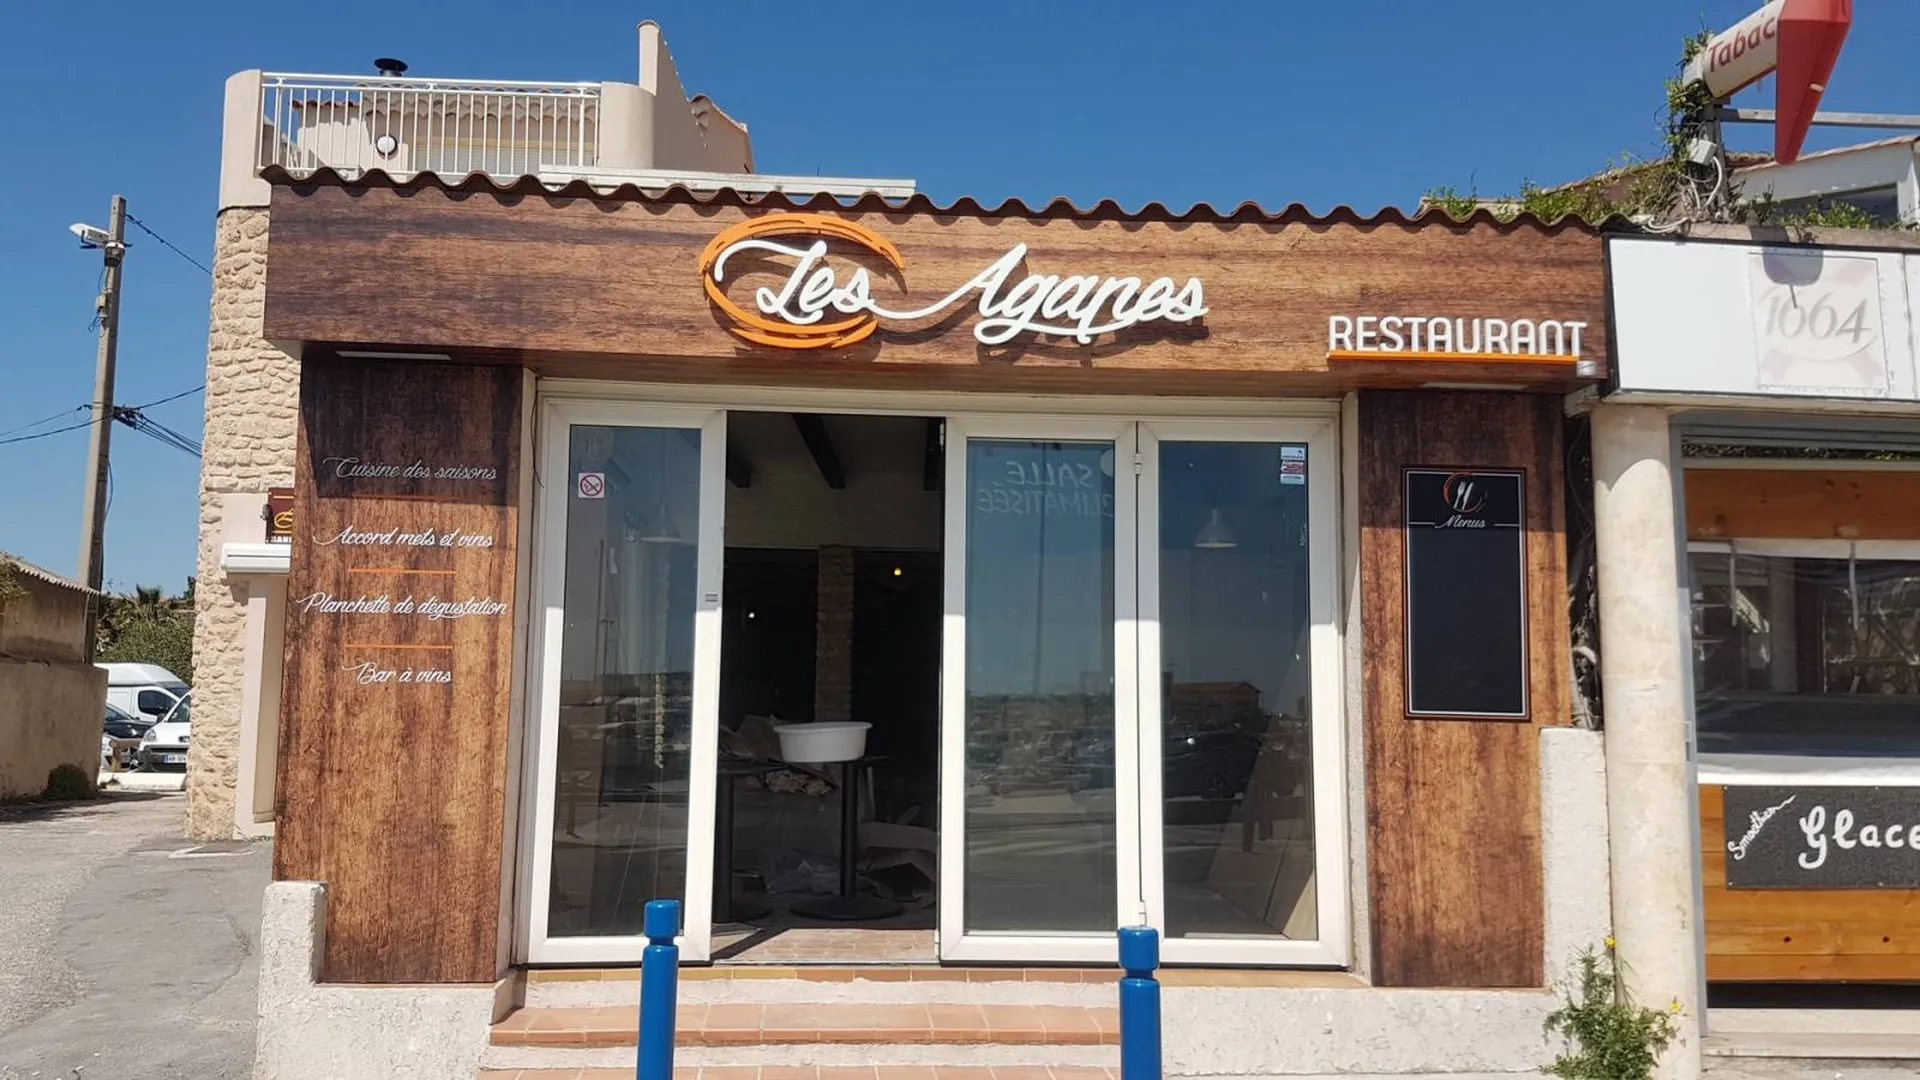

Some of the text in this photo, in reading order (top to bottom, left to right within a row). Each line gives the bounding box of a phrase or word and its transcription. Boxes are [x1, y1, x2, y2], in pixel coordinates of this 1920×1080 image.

[1708, 15, 1775, 73] Tabac
[714, 240, 875, 325] Les
[1328, 315, 1588, 357] RESTAURANT
[322, 456, 498, 480] Cuisine des saisons
[1434, 514, 1487, 529] Menus
[312, 525, 494, 548] Accord mets et vins
[296, 591, 508, 621] Planchette de dégustation
[342, 661, 452, 685] Bar à vins
